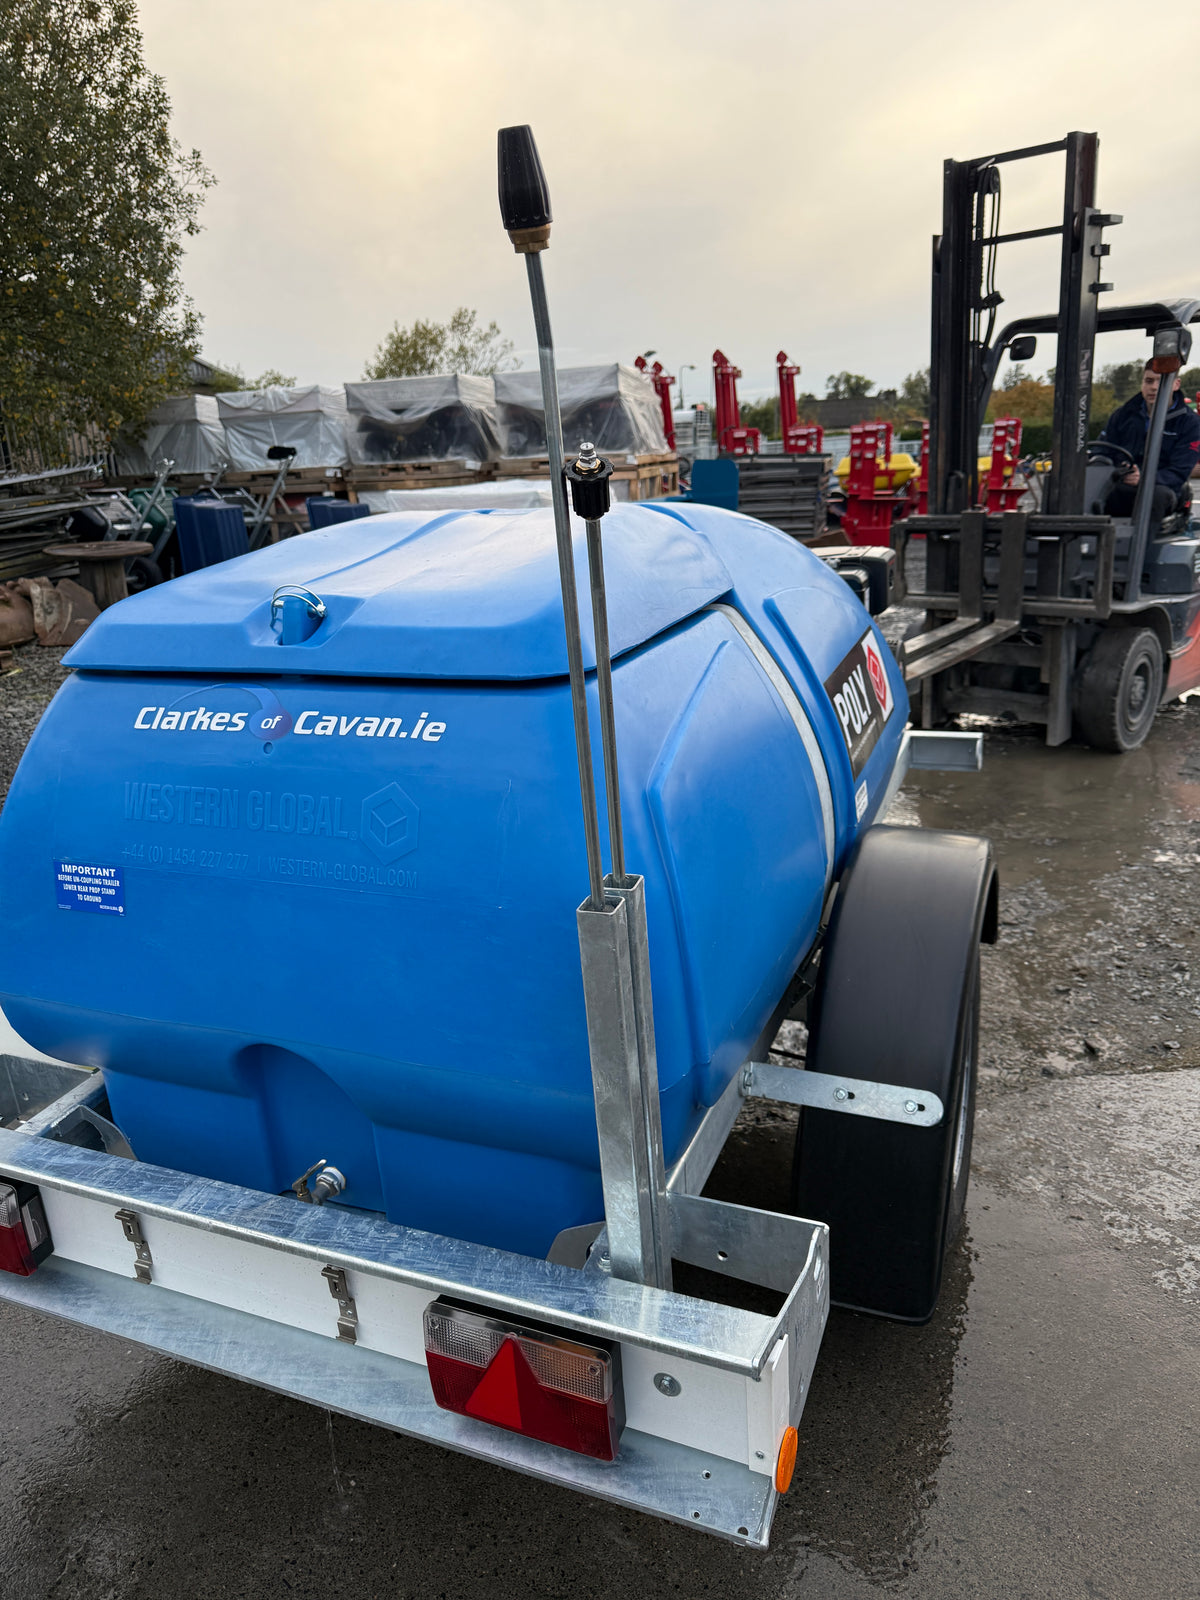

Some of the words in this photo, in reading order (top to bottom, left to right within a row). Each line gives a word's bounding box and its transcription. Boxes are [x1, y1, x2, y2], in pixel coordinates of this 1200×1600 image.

[833, 663, 872, 749] POLY
[133, 706, 249, 732] Clarkes
[260, 715, 283, 729] of
[293, 710, 447, 742] Cavan.ie
[123, 781, 239, 829] WESTERN
[61, 864, 116, 877] IMPORTANT
[121, 843, 145, 860] +44
[148, 845, 164, 863] (0)
[168, 847, 196, 865] 1454
[199, 850, 222, 868] 227
[226, 852, 249, 870] 277
[268, 855, 418, 889] WESTERN-GLOBAL.COM
[57, 874, 73, 882] BEFORE
[102, 879, 120, 887] TRAILER
[63, 883, 77, 891] LOWER
[83, 895, 102, 903] GROUND
